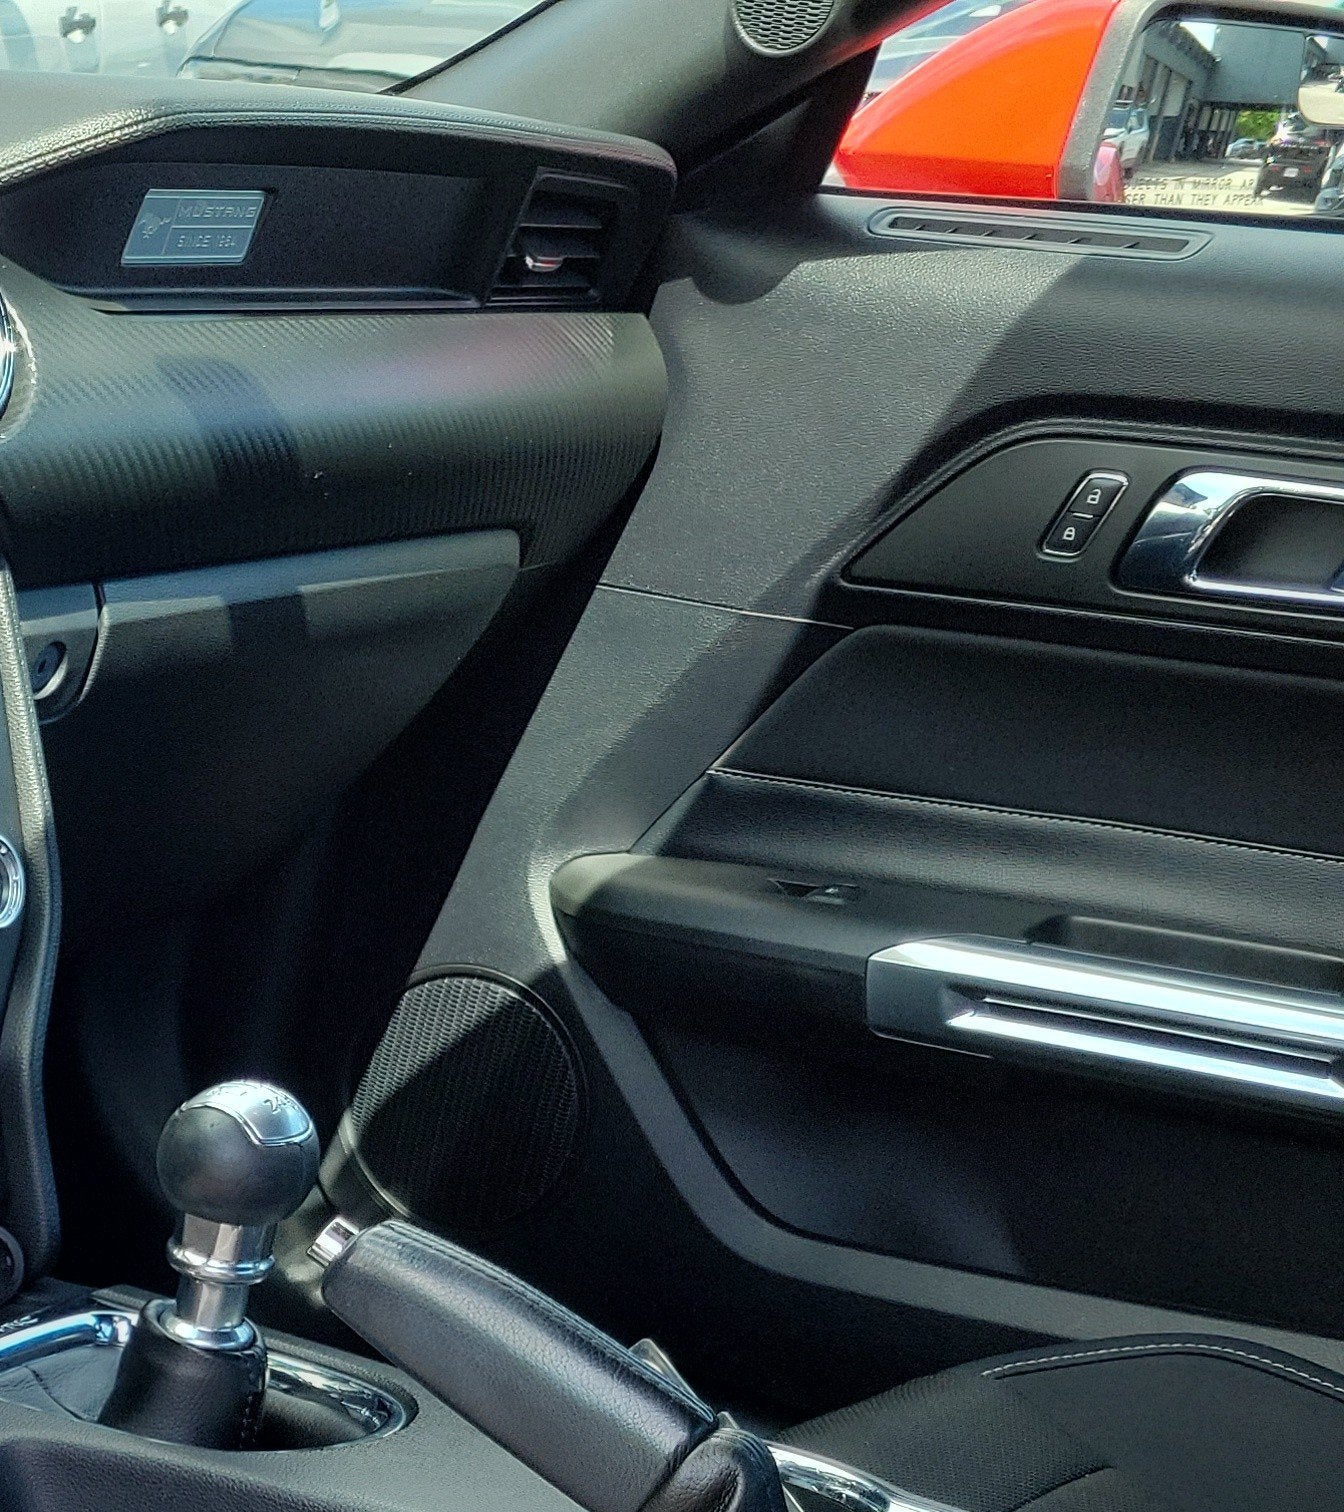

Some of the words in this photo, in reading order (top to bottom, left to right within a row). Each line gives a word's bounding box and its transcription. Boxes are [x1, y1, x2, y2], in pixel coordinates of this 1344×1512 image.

[1194, 178, 1231, 190] MIRROR
[1240, 179, 1255, 191] AR
[1125, 193, 1145, 205] SER
[1154, 193, 1184, 206] THAN
[1191, 194, 1217, 206] THEY
[178, 206, 257, 218] MUSTANG
[177, 235, 211, 248] SINCE
